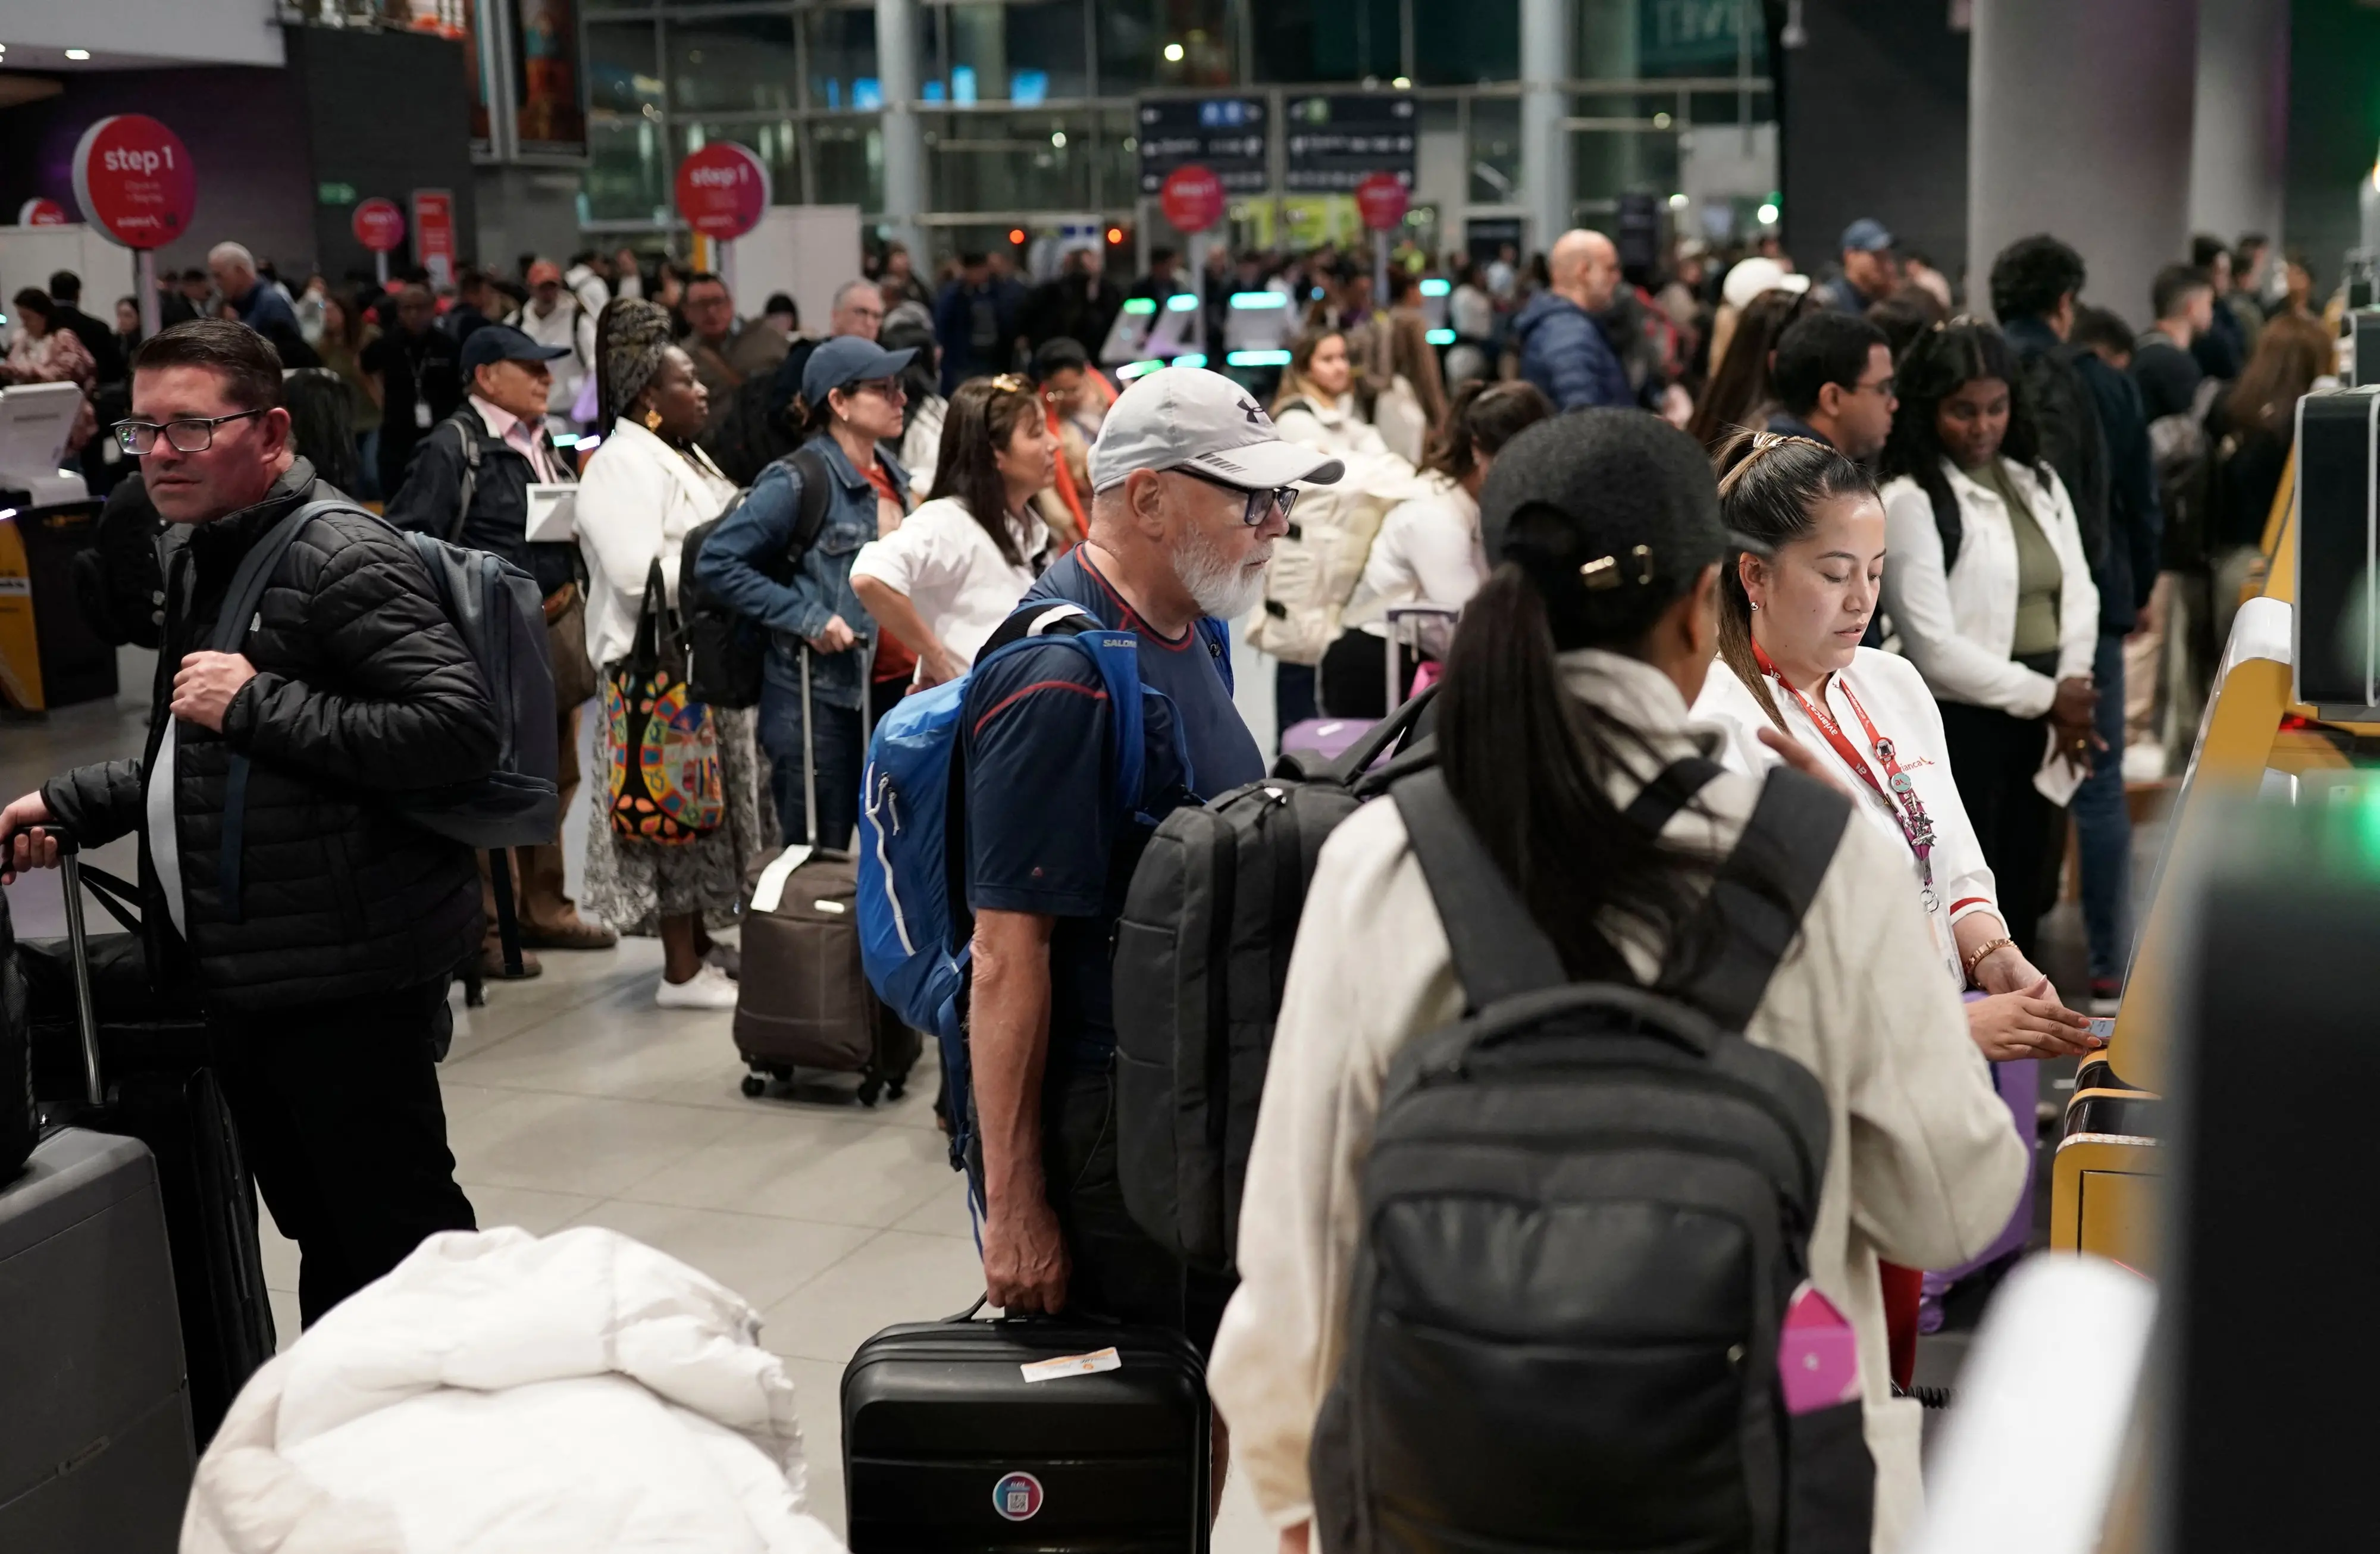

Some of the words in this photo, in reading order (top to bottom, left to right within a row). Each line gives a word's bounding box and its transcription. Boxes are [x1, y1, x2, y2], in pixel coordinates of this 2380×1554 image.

[104, 146, 159, 177] step
[161, 145, 174, 171] 1
[1811, 706, 1839, 736] avianca
[1900, 760, 1922, 772] ianca
